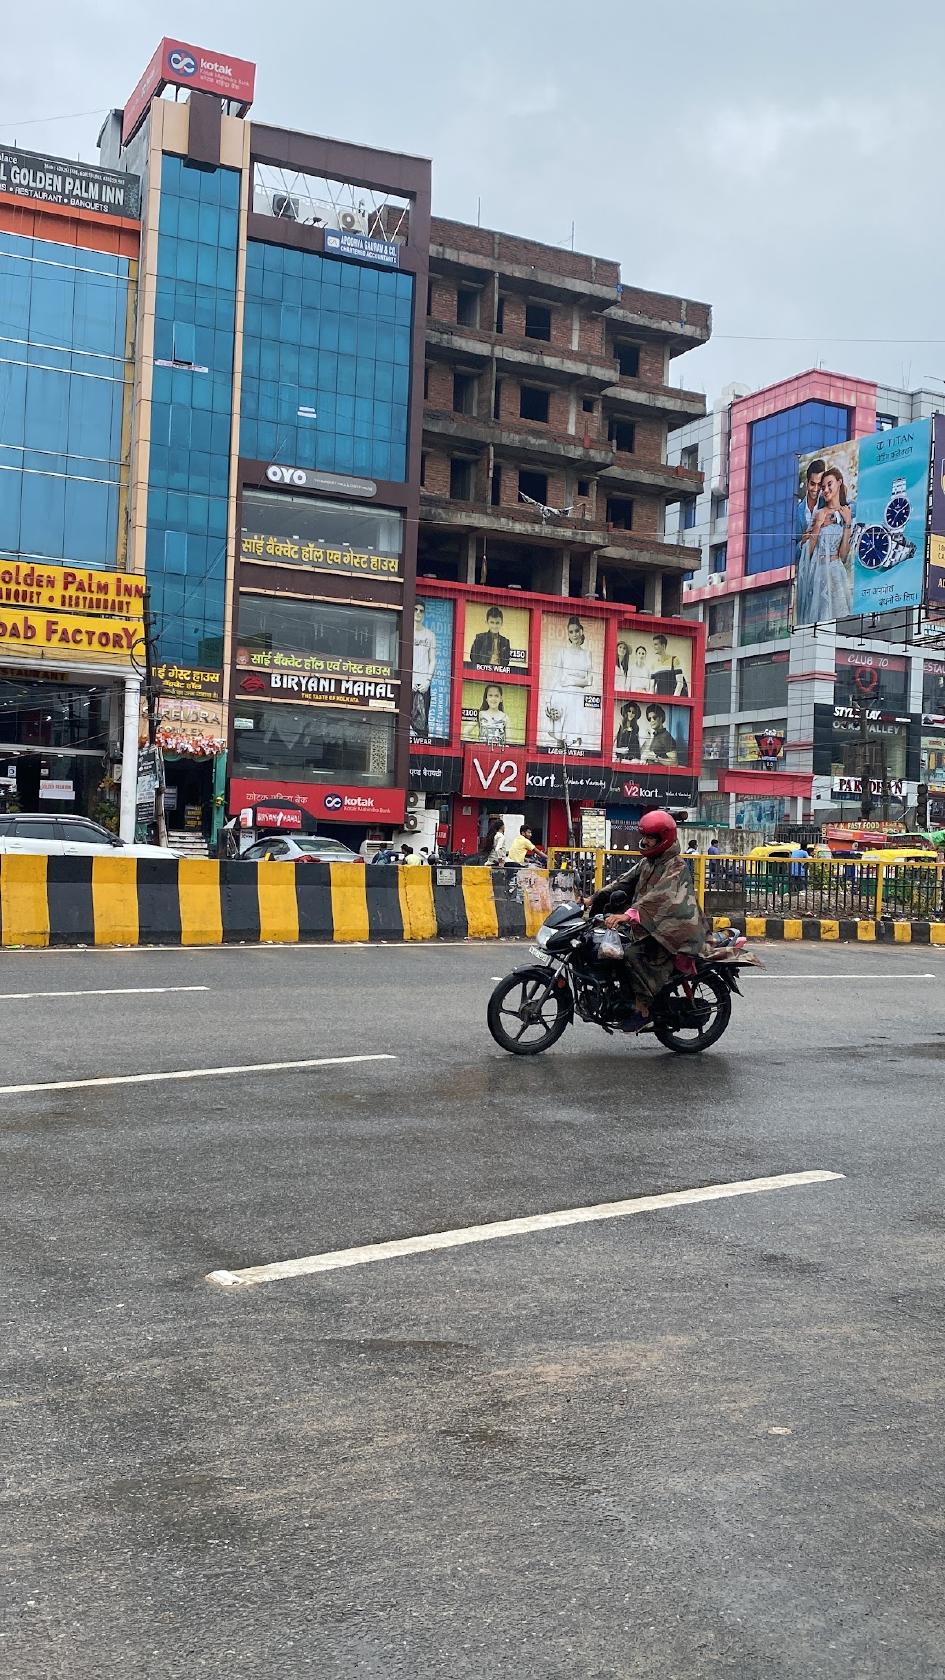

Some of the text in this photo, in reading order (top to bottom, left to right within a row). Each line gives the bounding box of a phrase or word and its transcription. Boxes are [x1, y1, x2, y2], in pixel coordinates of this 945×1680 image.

[201, 58, 232, 76] kotak
[11, 165, 62, 192] GOLDEN
[65, 176, 98, 200] PALM
[102, 184, 124, 205] INN
[15, 185, 63, 203] RESTAURANT
[70, 198, 109, 213] BANQUETS
[887, 433, 914, 447] TITAN
[267, 465, 307, 485] OYO
[301, 542, 324, 562] हॉल
[343, 547, 368, 568] गेस्ट
[370, 555, 399, 573] हाउस
[61, 594, 131, 613] RESTAURANT
[304, 656, 325, 671] हॉल
[343, 659, 364, 674] गेस्ट
[365, 663, 392, 677] हाउस
[494, 665, 510, 673] WEAR
[847, 654, 873, 666] CLUB
[168, 665, 191, 680] गेस्ट
[193, 672, 220, 683] हाउस
[271, 673, 395, 699] BIRYANI MAHAL
[413, 737, 432, 745] WEAR
[473, 758, 518, 793] V2
[526, 773, 556, 788] kart
[624, 785, 639, 796] V2
[640, 788, 659, 797] kart
[345, 796, 374, 807] kotak
[847, 822, 861, 830] FAST
[863, 821, 880, 830] FOOD
